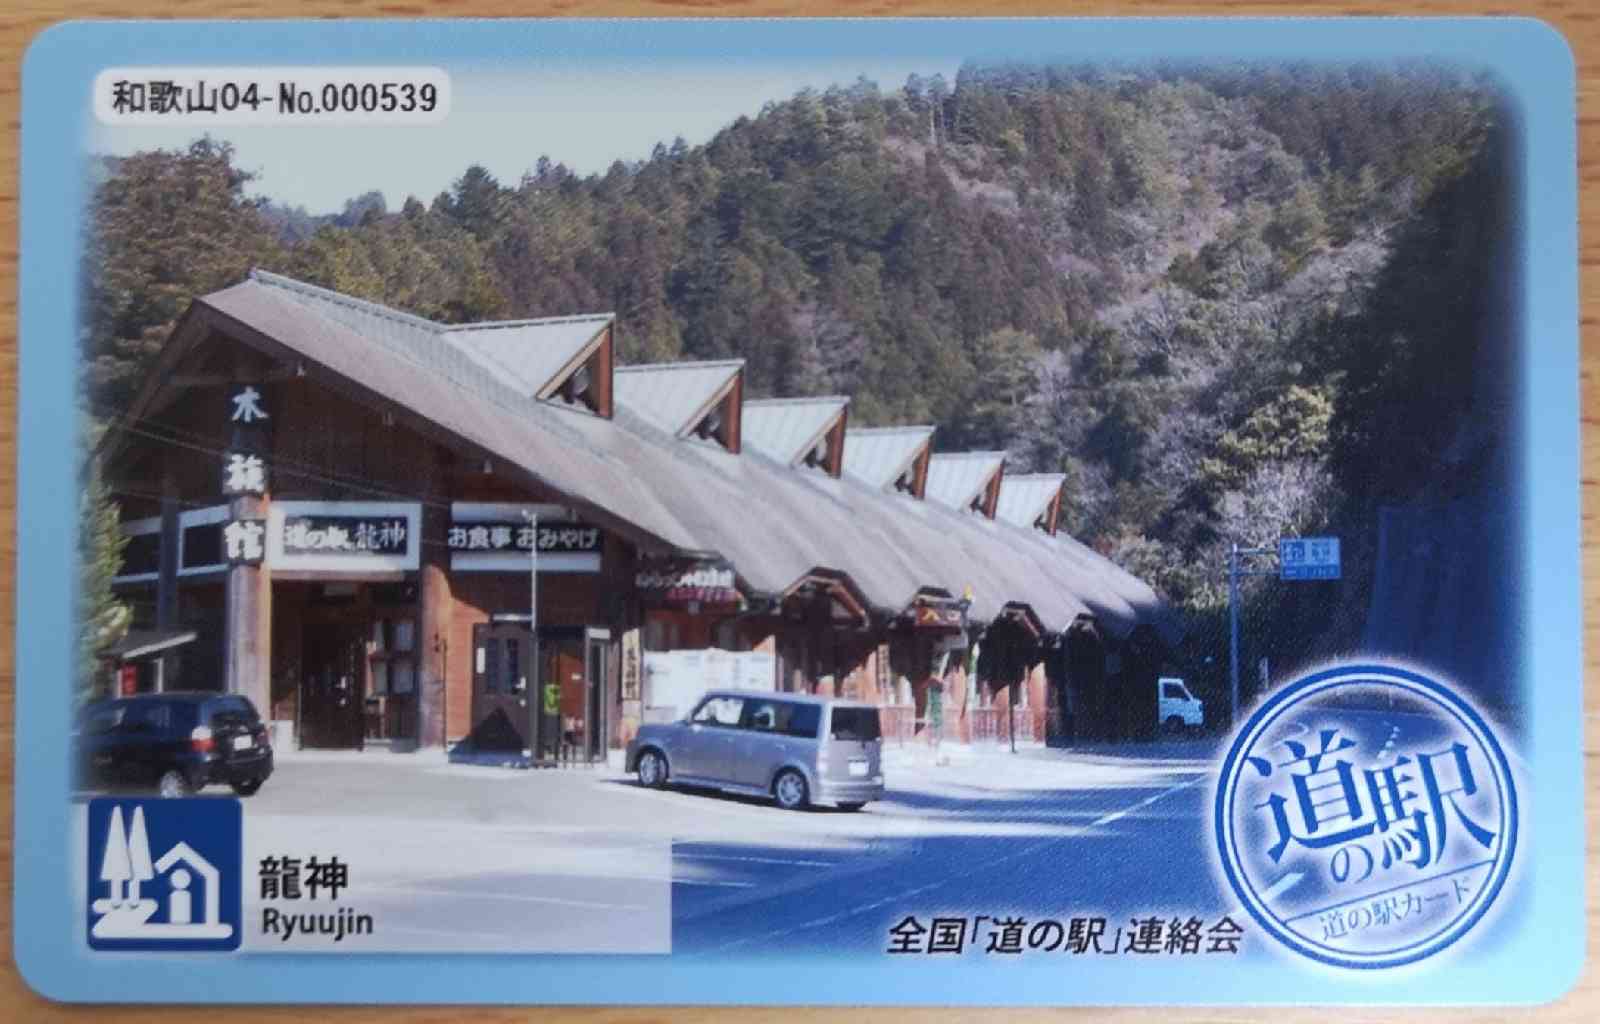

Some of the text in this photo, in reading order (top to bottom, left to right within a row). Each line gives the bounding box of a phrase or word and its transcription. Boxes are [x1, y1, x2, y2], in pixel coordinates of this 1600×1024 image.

[113, 80, 437, 114] 和歌山04-No.000539
[448, 527, 598, 549] お食事 おみやげ
[1248, 730, 1496, 884] 道の駅
[259, 856, 348, 900] 龍神
[262, 908, 373, 941] Ryuujin
[1320, 879, 1471, 941] 道の駅カード
[886, 915, 1244, 955] 全国「道の駅」連絡会
